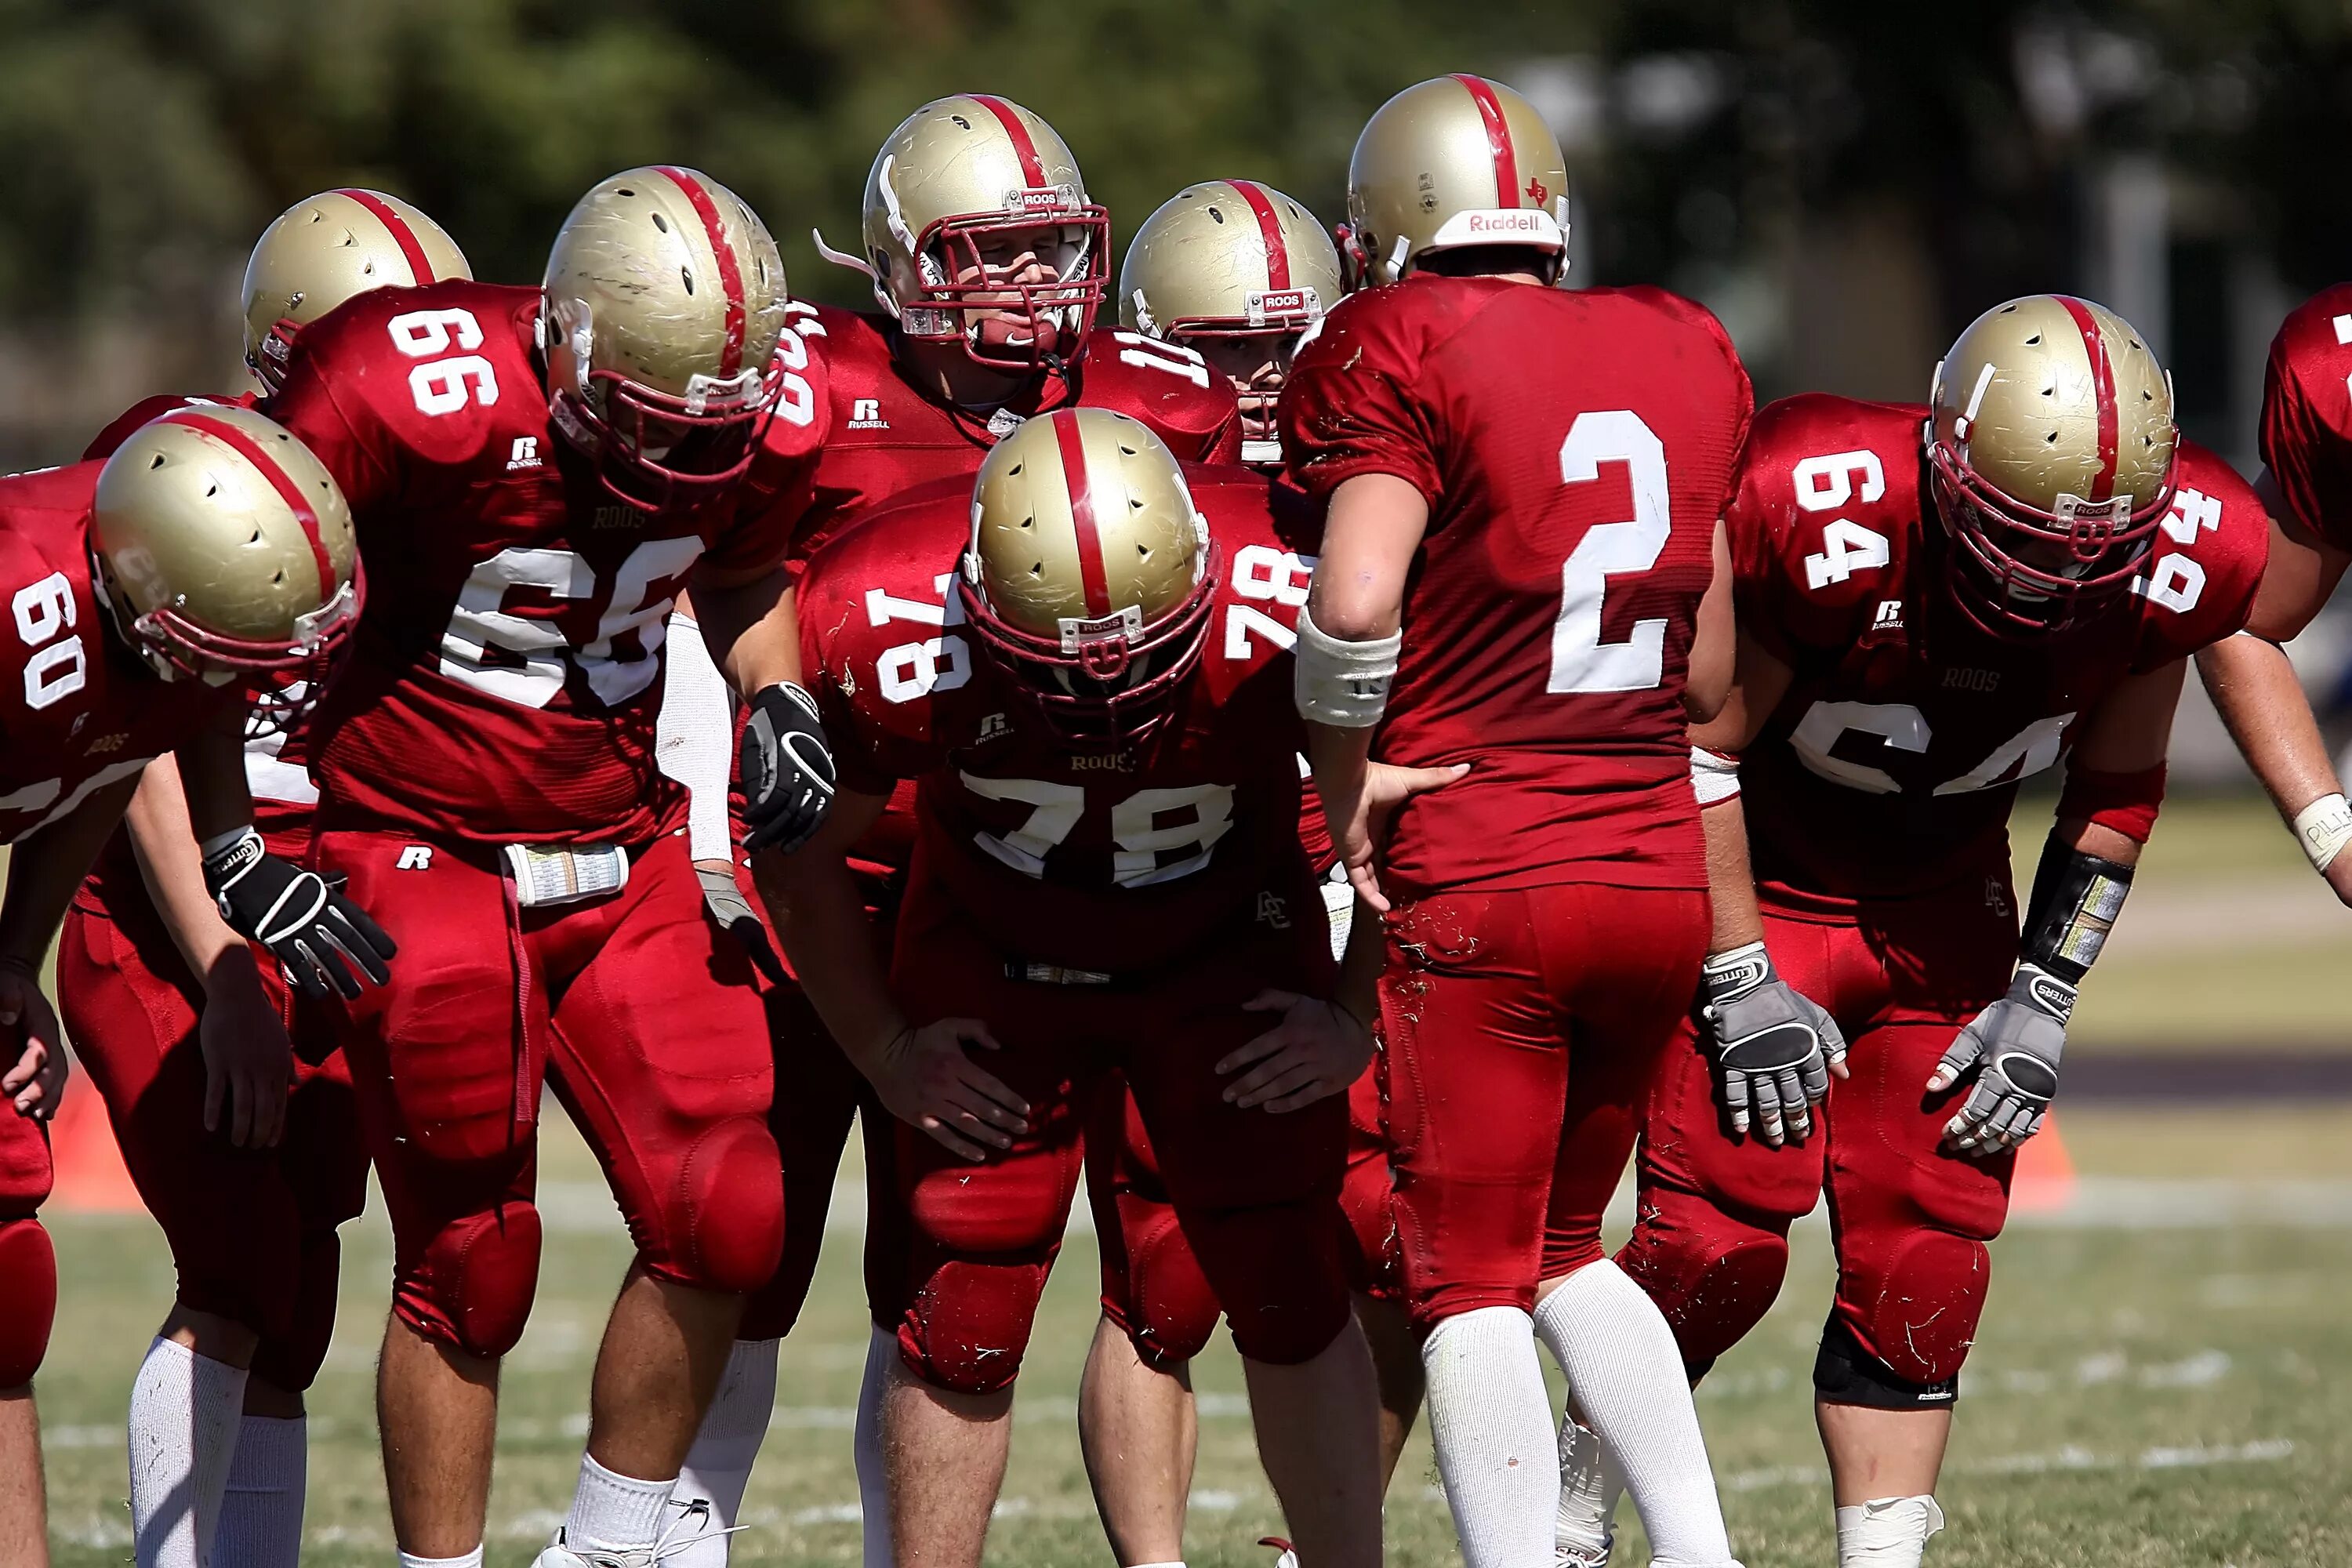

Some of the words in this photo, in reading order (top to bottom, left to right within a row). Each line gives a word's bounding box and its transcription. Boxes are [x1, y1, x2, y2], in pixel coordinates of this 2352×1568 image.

[1023, 194, 1056, 205] ROOS
[1536, 187, 1544, 199] 2
[1470, 214, 1539, 231] Riddell
[1265, 295, 1299, 307] ROOS
[387, 307, 499, 416] 66
[1113, 332, 1210, 389] 11
[854, 399, 879, 420] R
[848, 420, 890, 430] RUSSELL
[511, 436, 538, 462] R
[1792, 449, 1889, 590] 64
[2076, 506, 2111, 515] ROOS
[1546, 410, 1672, 695] 2
[2132, 487, 2223, 614] 64
[1225, 544, 1319, 660] 78
[1876, 601, 1902, 622] R
[440, 535, 706, 710] 66
[1083, 618, 1120, 632] ROOS
[12, 572, 87, 708] 60
[866, 572, 973, 705] 78
[1940, 668, 2001, 692] ROOS
[981, 713, 1005, 736] R
[975, 728, 1015, 746] RUSSELL
[960, 769, 1236, 888] 78
[396, 846, 433, 869] R
[2037, 983, 2077, 1016] UTTERS
